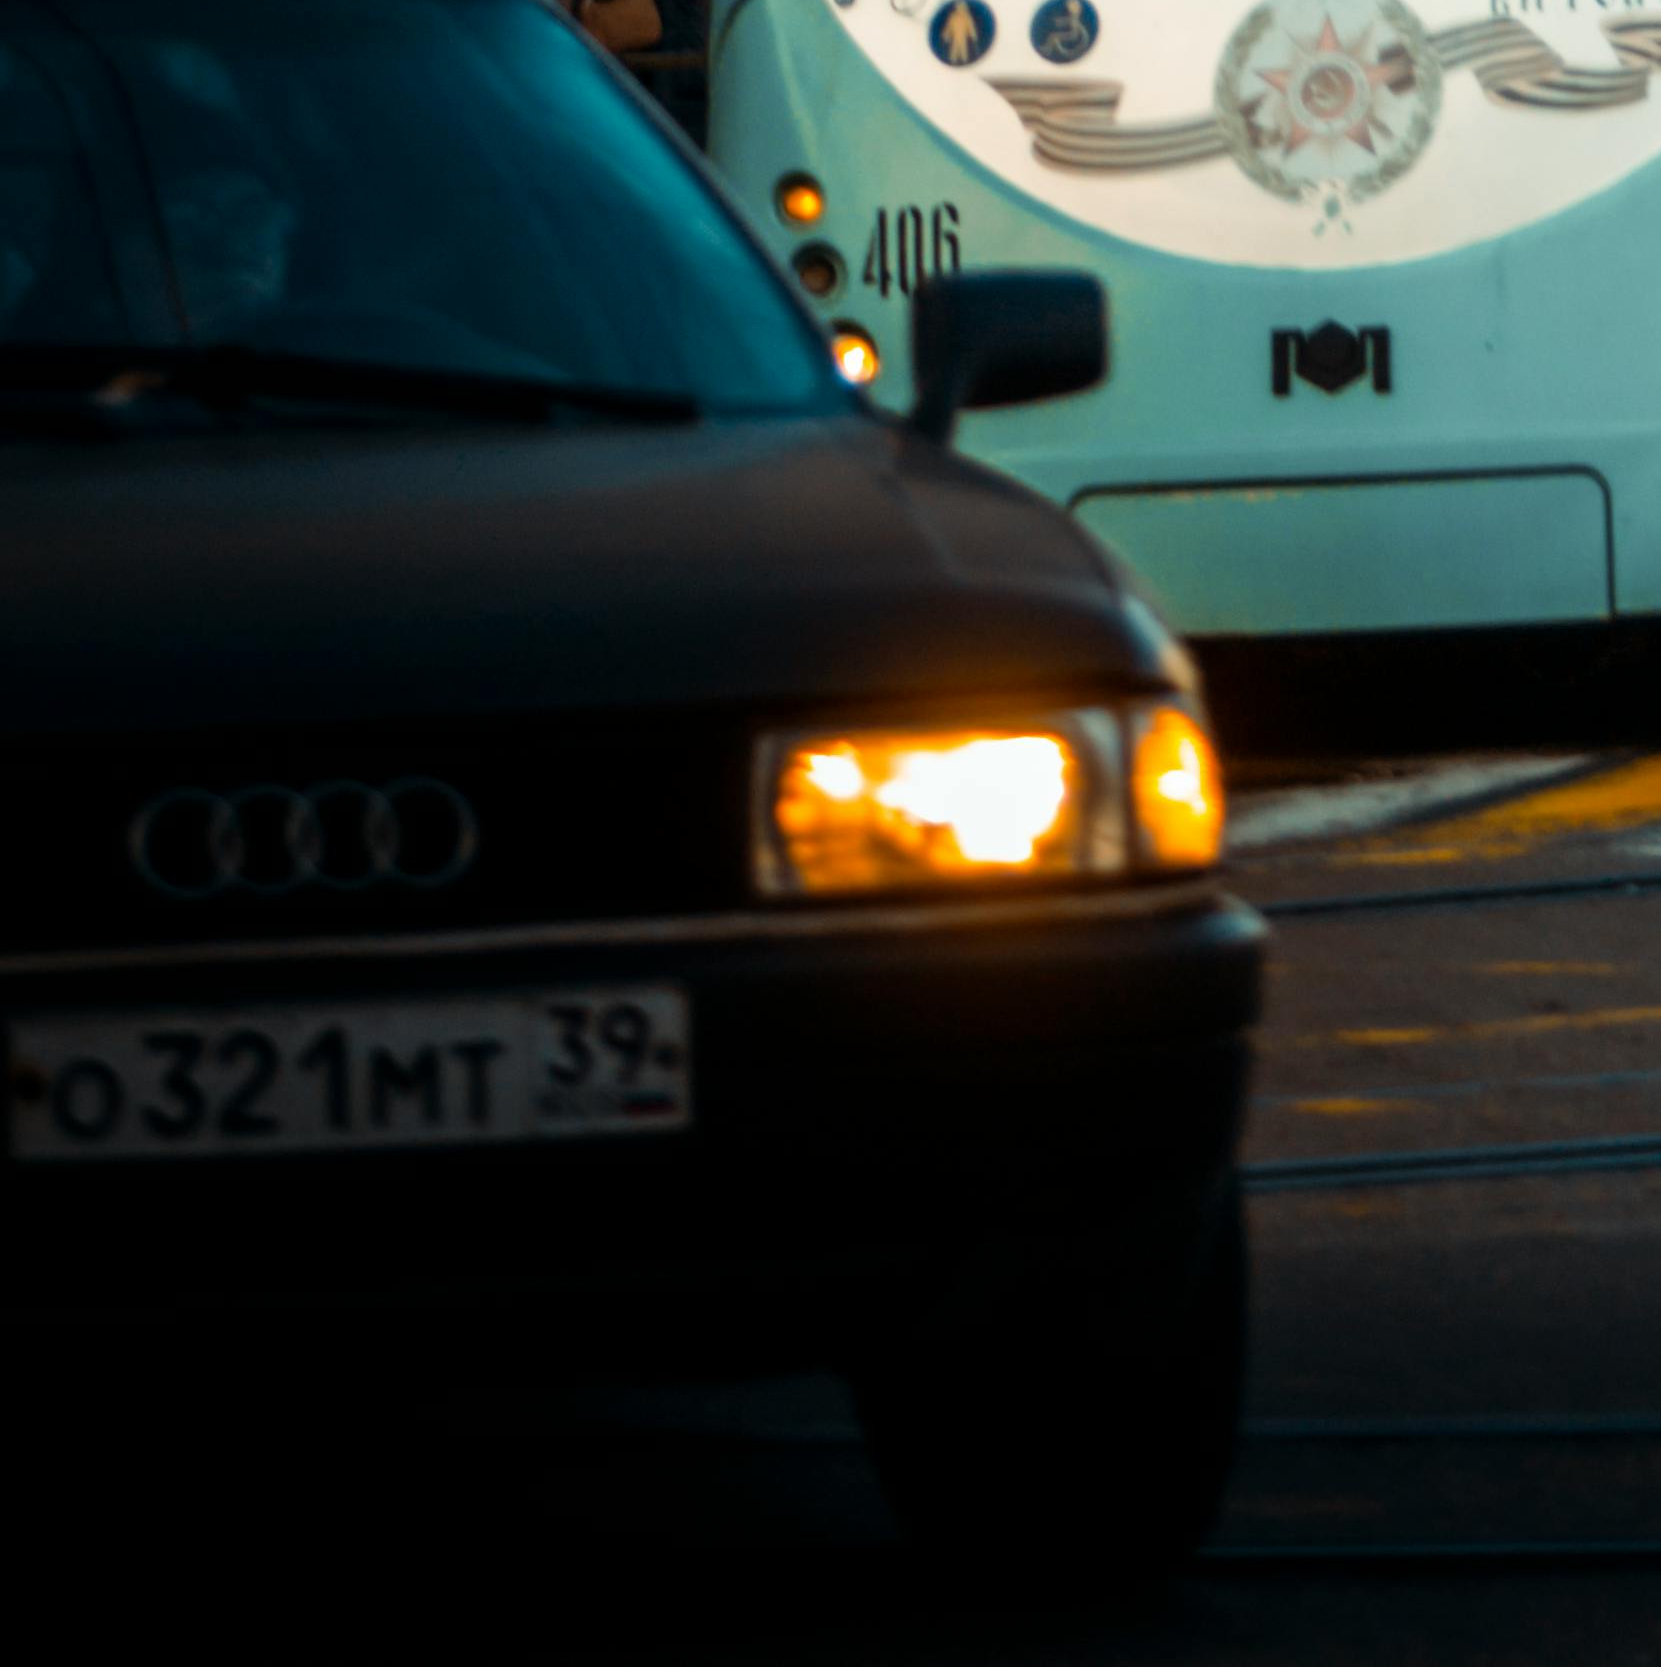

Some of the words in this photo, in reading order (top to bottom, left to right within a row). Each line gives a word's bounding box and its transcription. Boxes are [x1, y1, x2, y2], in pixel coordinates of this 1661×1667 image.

[862, 200, 961, 299] 406
[51, 1024, 503, 1140] О321МТ
[547, 1003, 650, 1085] 39
